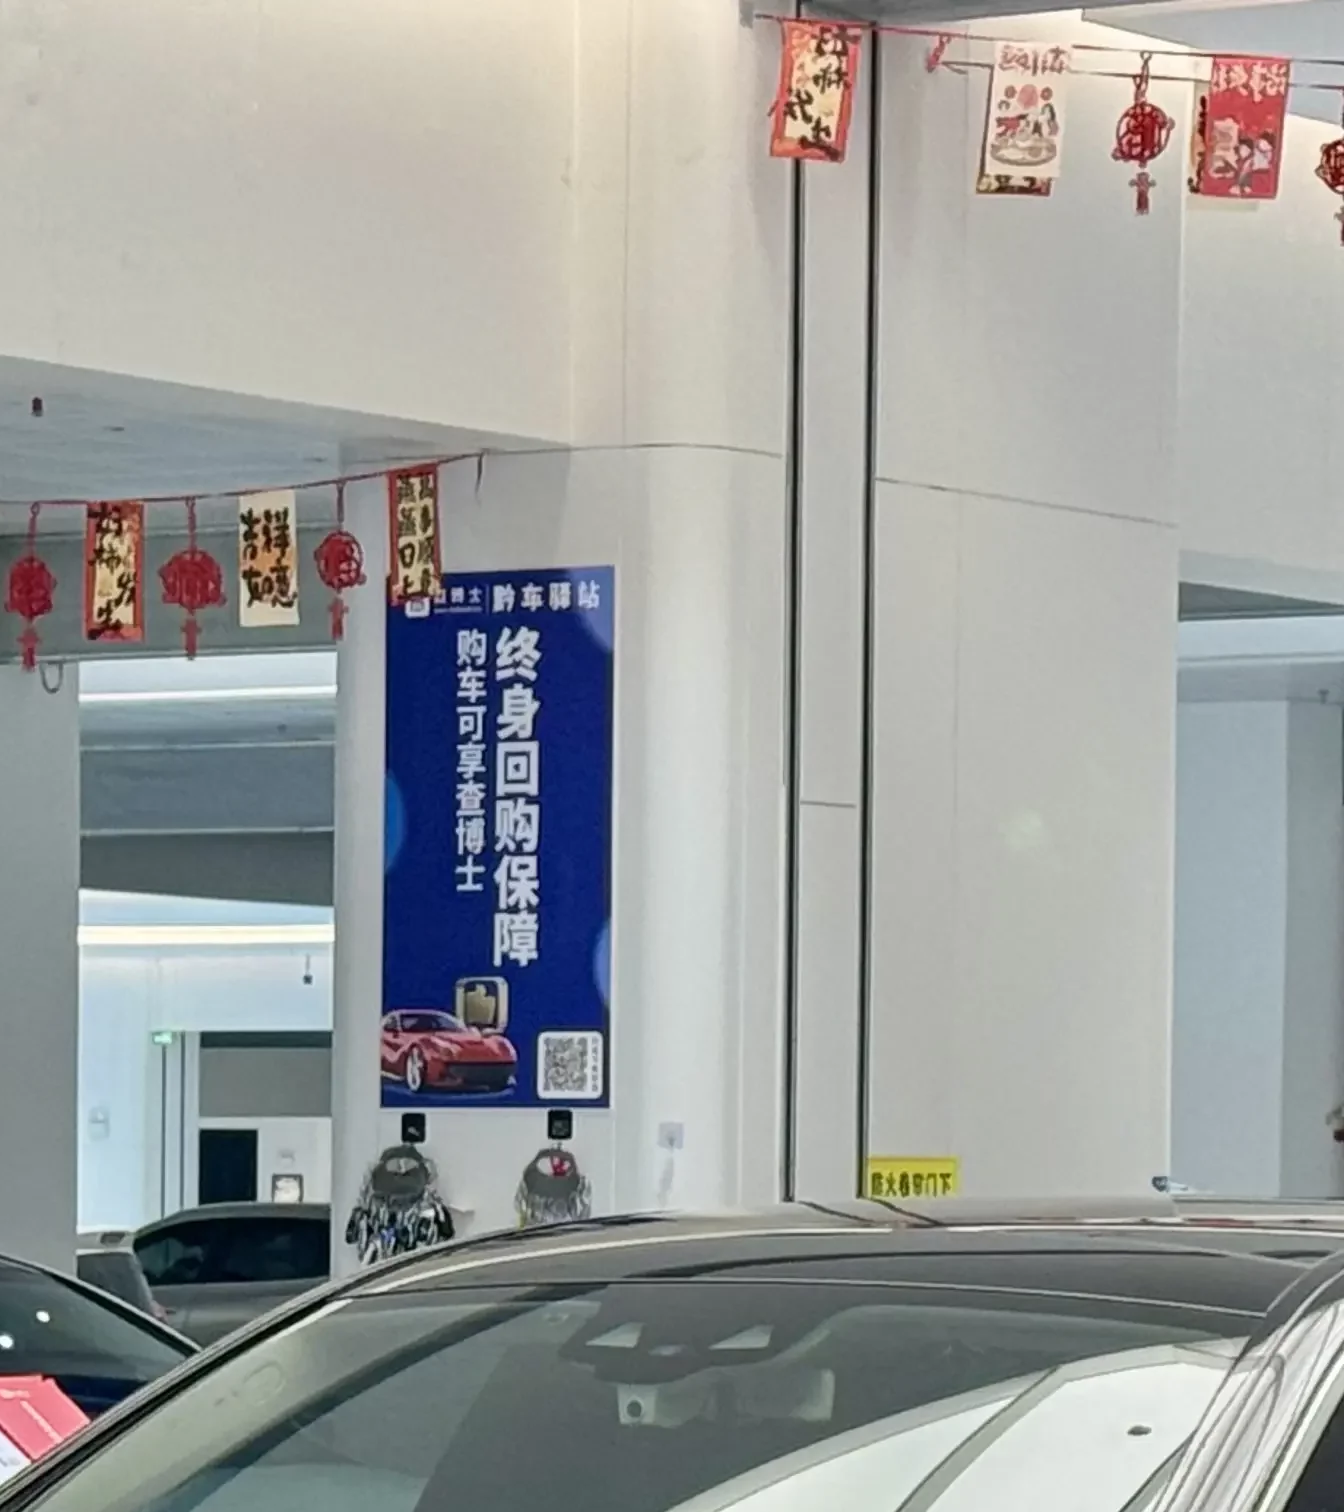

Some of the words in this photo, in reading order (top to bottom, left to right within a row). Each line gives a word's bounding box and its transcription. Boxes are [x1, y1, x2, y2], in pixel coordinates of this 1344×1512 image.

[454, 627, 488, 892] 购车可享查博士
[493, 625, 543, 968] 终身回购保障
